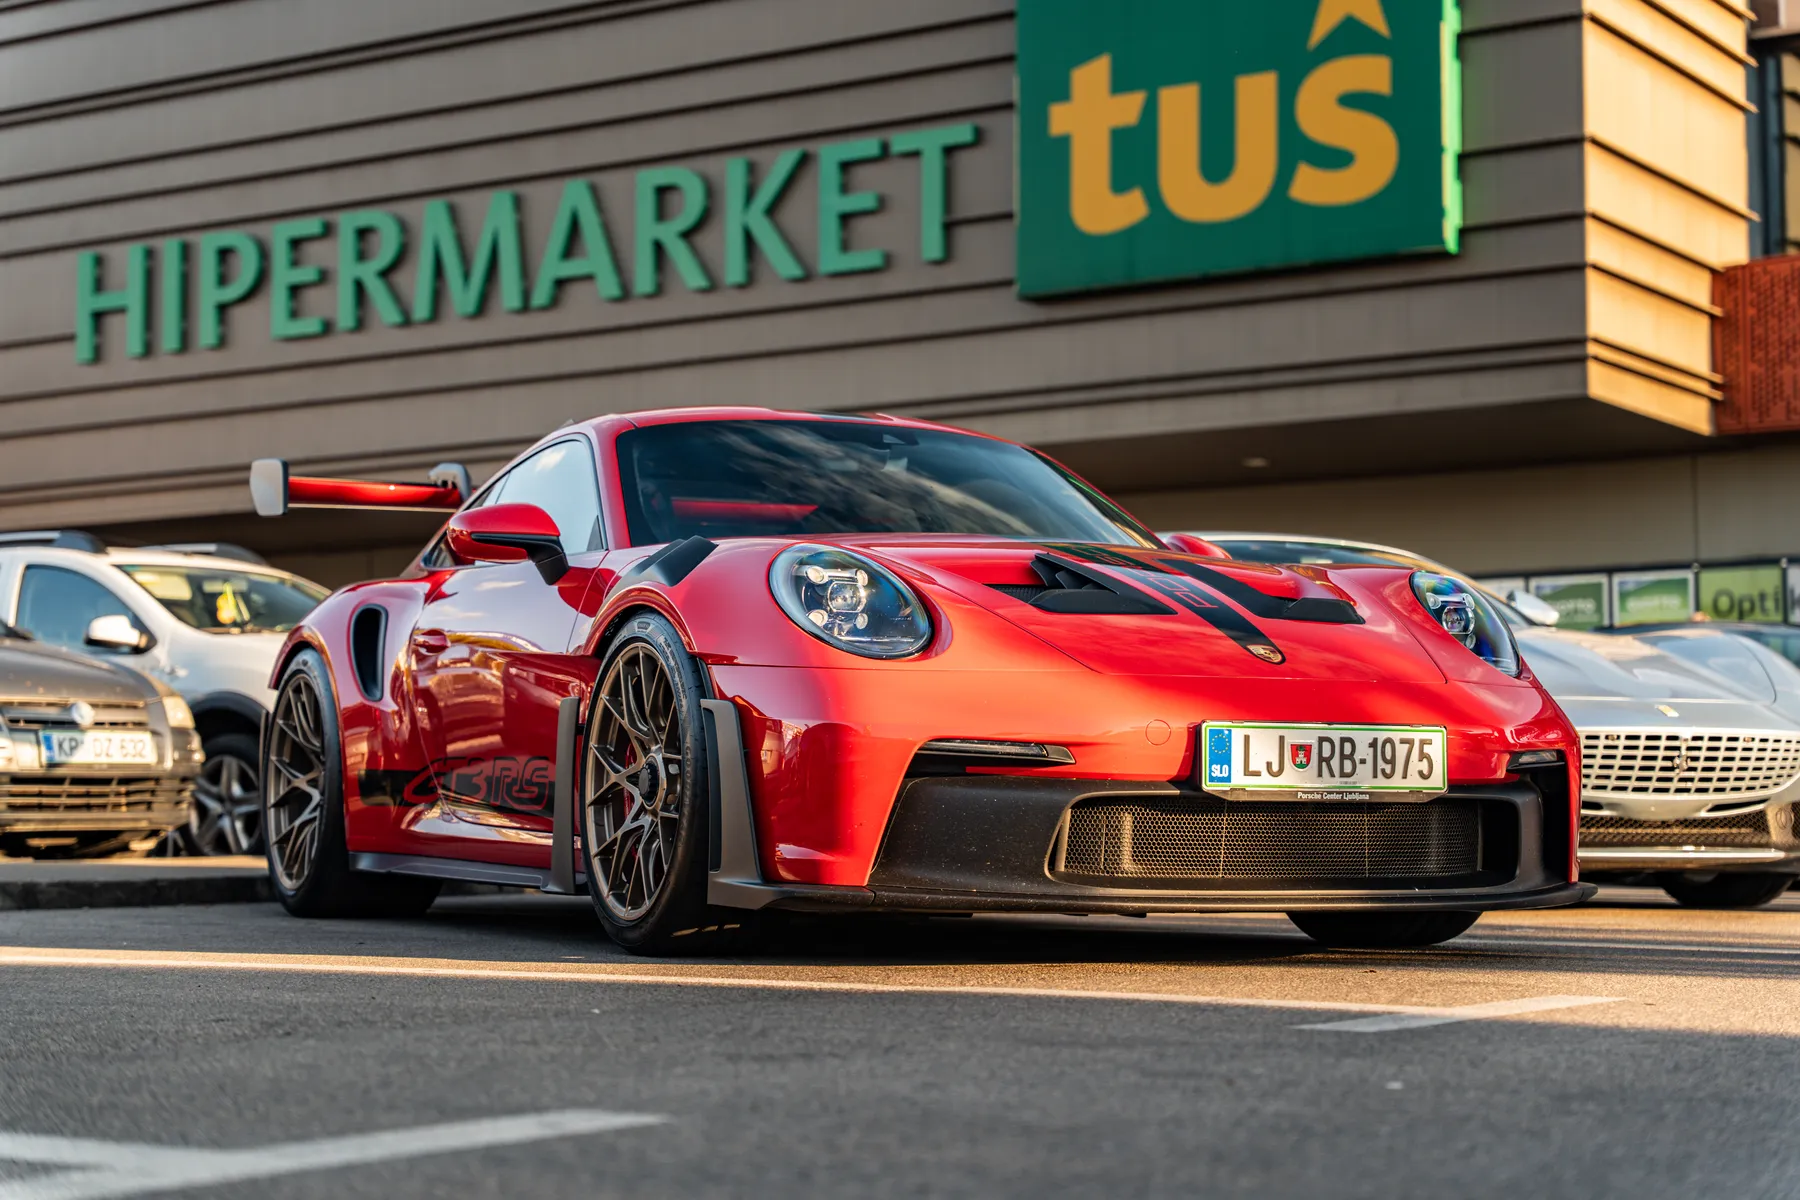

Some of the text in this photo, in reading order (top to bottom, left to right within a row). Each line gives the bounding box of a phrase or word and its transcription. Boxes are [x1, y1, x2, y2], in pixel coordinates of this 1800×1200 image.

[75, 122, 978, 364] HIPERMARKET
[57, 736, 79, 757] KP
[1243, 734, 1434, 780] LJ RB-1975
[1211, 764, 1229, 778] SLO
[1297, 791, 1370, 801] Porsche Center Ljubljana
